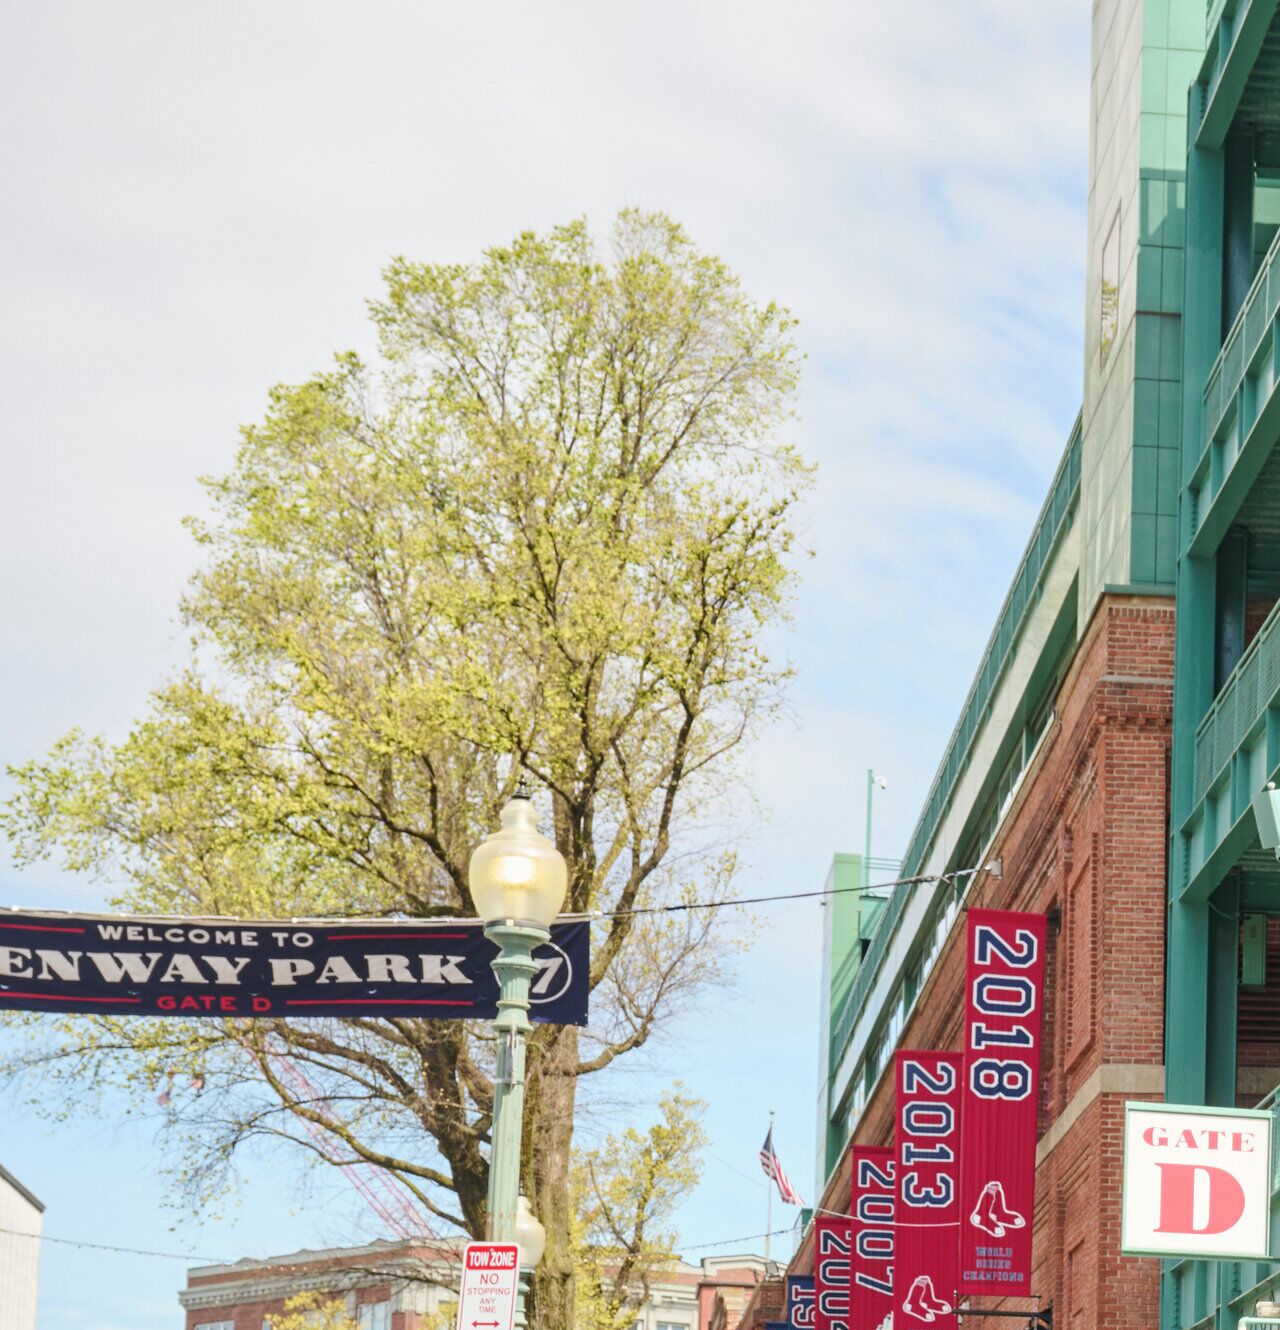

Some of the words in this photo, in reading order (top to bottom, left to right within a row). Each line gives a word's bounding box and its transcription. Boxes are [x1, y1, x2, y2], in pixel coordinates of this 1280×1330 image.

[97, 924, 259, 947] WELCOME
[272, 932, 314, 948] TO
[268, 954, 474, 986] PARK
[157, 995, 237, 1011] GATE
[253, 996, 272, 1012] D
[970, 925, 1038, 1101] 2018
[902, 1060, 956, 1208] 2013
[1142, 1126, 1255, 1152] GATE
[1153, 1162, 1246, 1235] D
[855, 1159, 896, 1296] 2007
[469, 1252, 489, 1267] TOW
[490, 1251, 515, 1267] ZONE
[975, 1247, 1013, 1257] WORLD
[976, 1259, 1012, 1269] SERIES
[480, 1273, 499, 1285] NO
[963, 1271, 1024, 1282] CHAMPIONS
[467, 1287, 510, 1296] STOPPING
